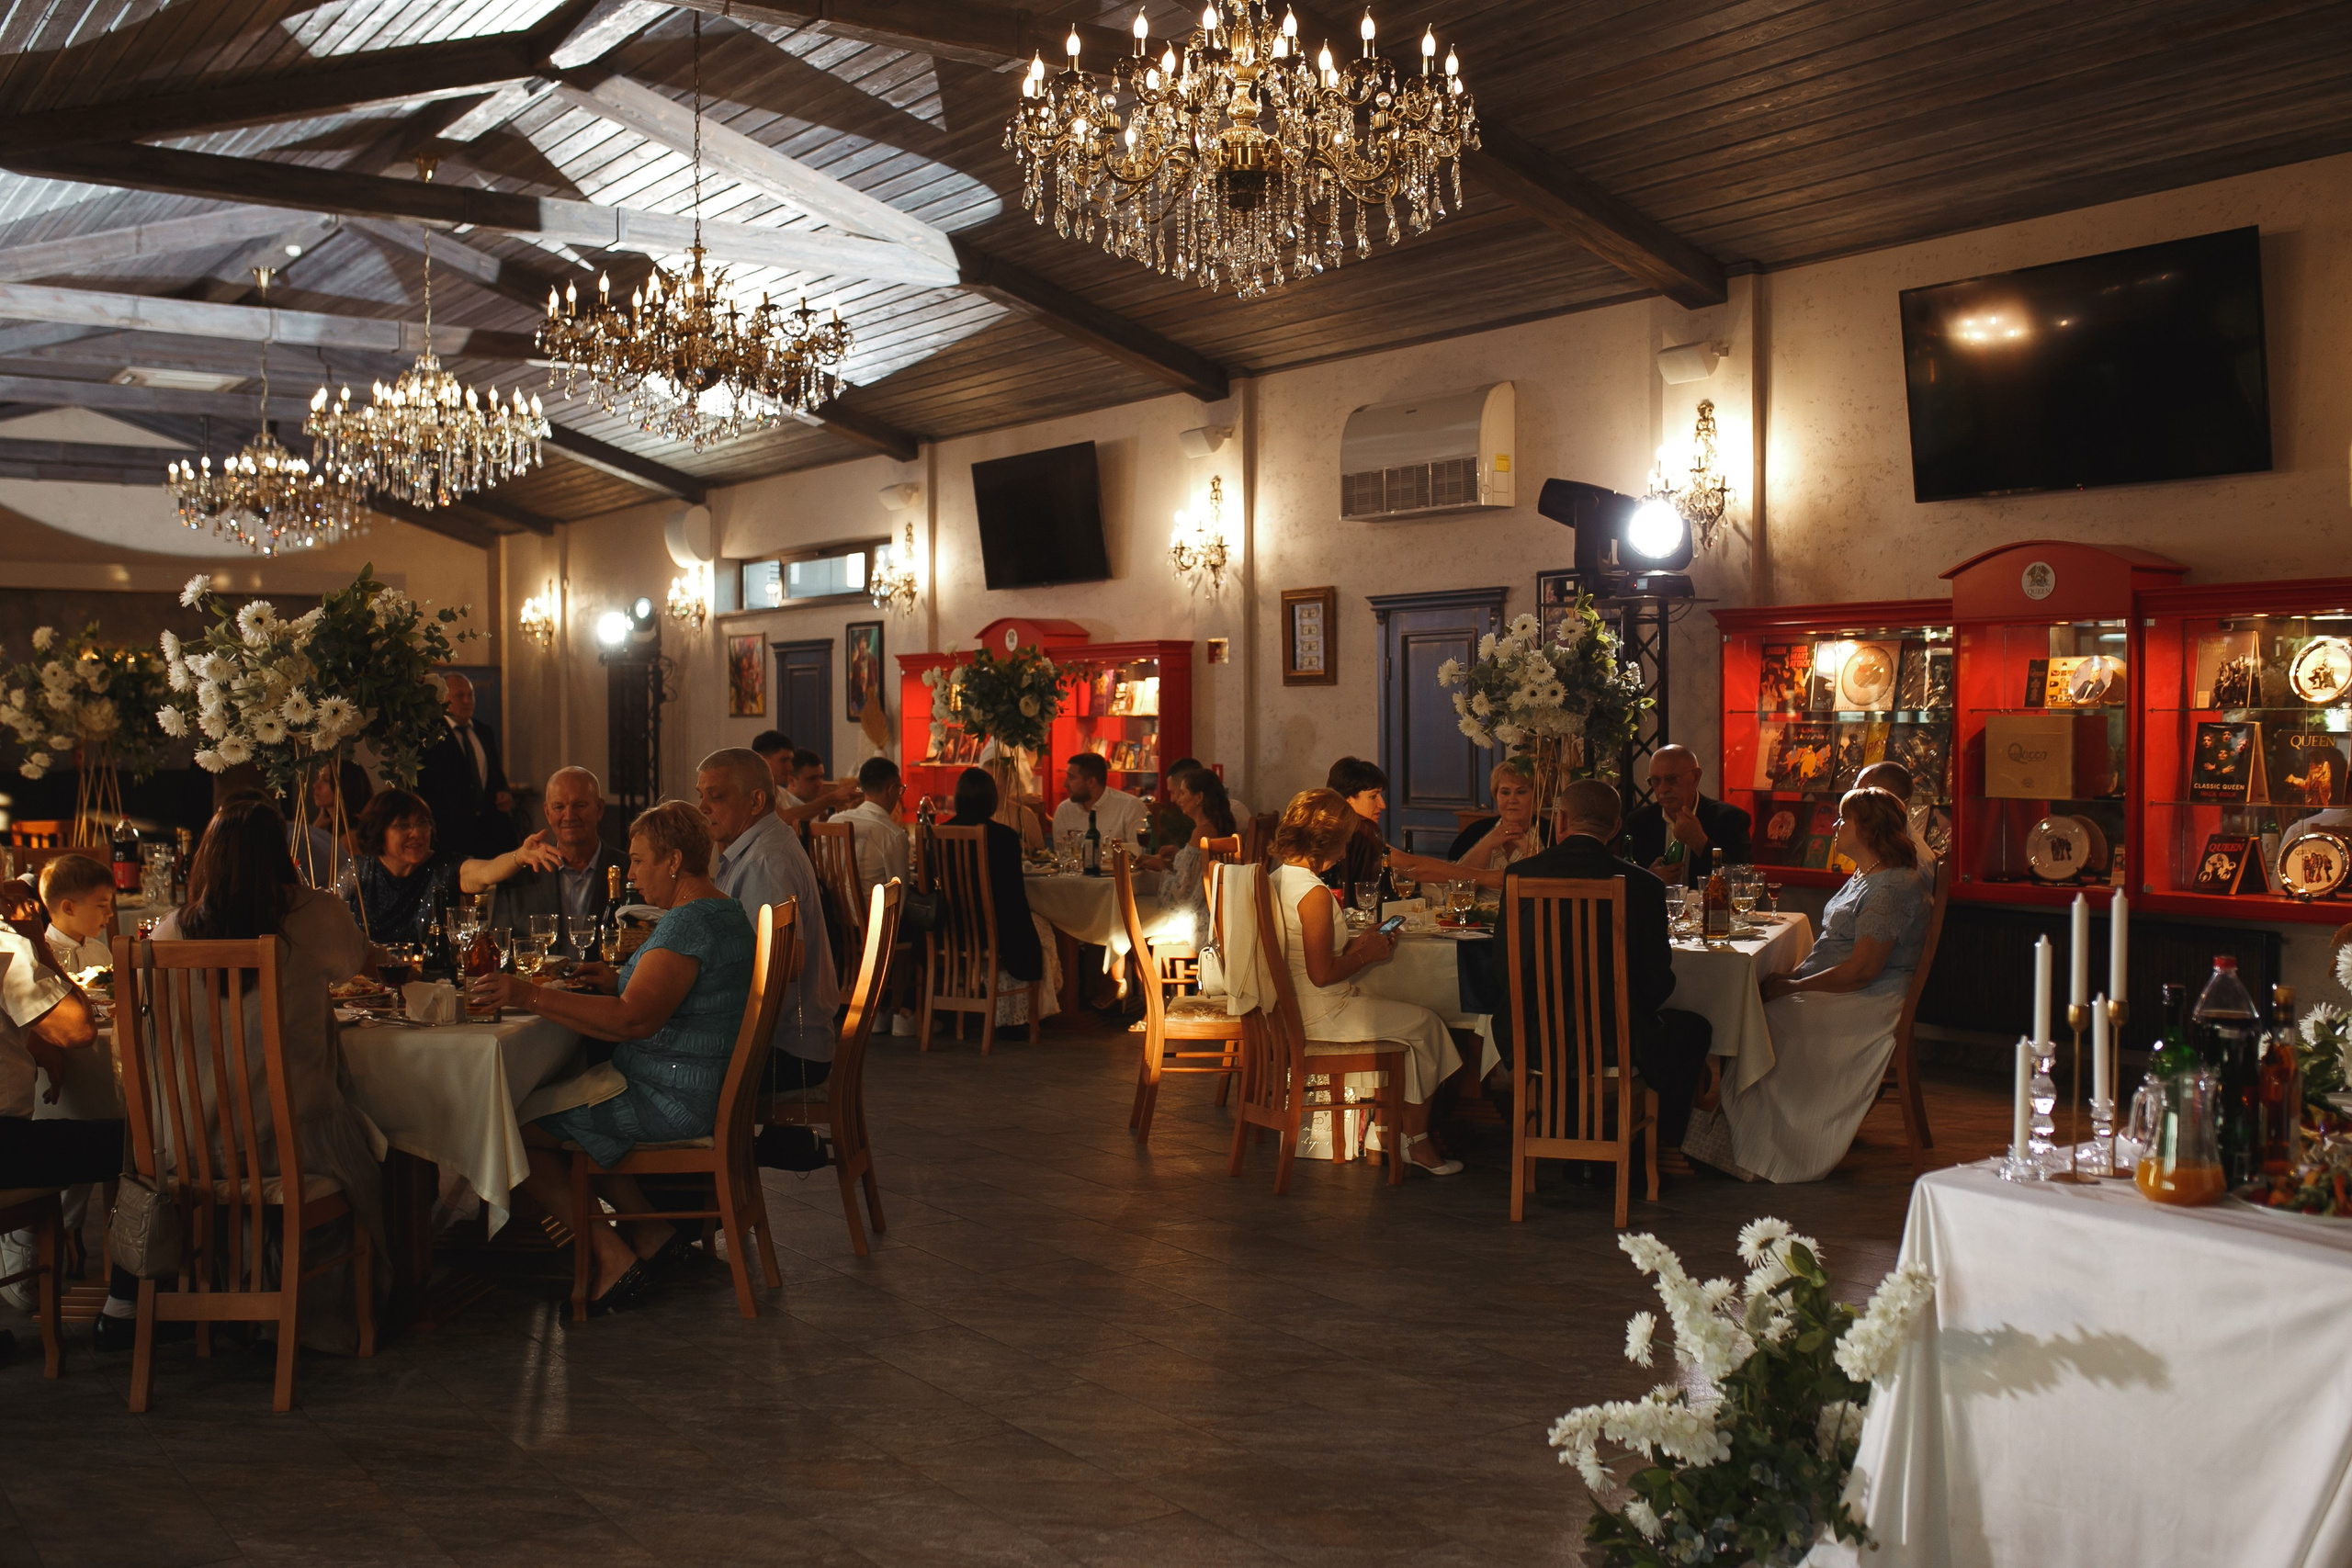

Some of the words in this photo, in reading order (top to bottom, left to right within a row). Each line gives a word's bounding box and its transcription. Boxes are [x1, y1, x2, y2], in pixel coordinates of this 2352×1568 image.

[2027, 588, 2051, 597] QUEEN
[1765, 646, 1787, 655] QUEEN
[1789, 660, 1811, 668] ATTACK
[2290, 734, 2336, 750] QUEEN
[2007, 742, 2048, 764] Queen
[2208, 842, 2245, 852] QUEEN
